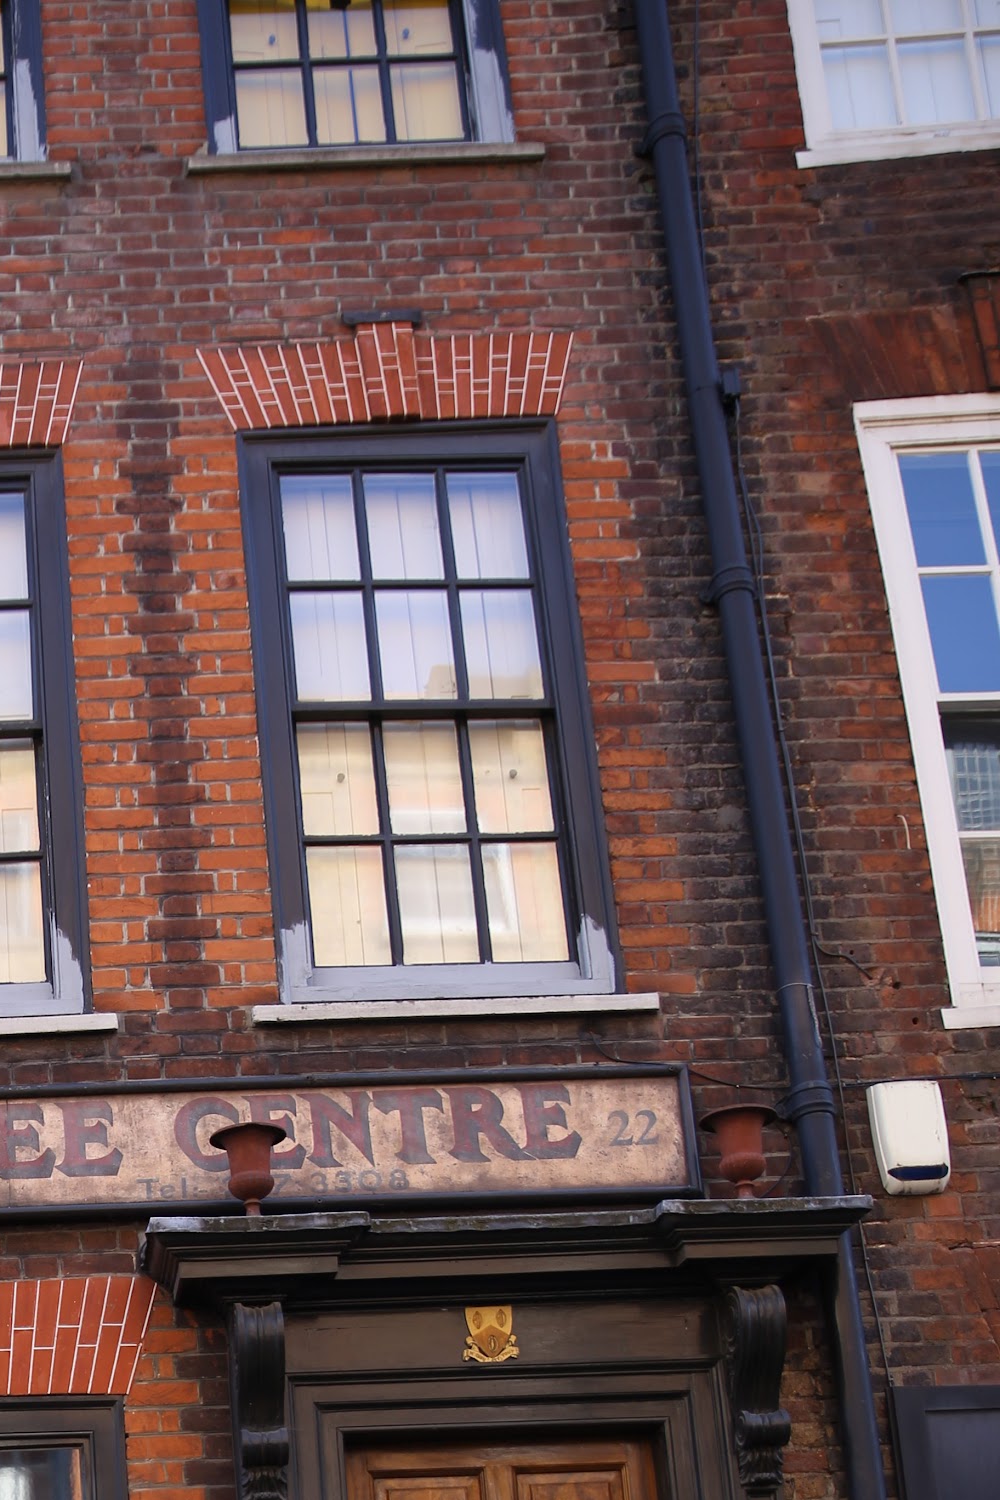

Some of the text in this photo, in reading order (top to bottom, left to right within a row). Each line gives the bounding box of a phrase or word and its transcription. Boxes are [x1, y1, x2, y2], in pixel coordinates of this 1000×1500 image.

[174, 1083, 582, 1172] CENTRE
[607, 1109, 660, 1146] 22
[310, 1169, 410, 1193] 3308
